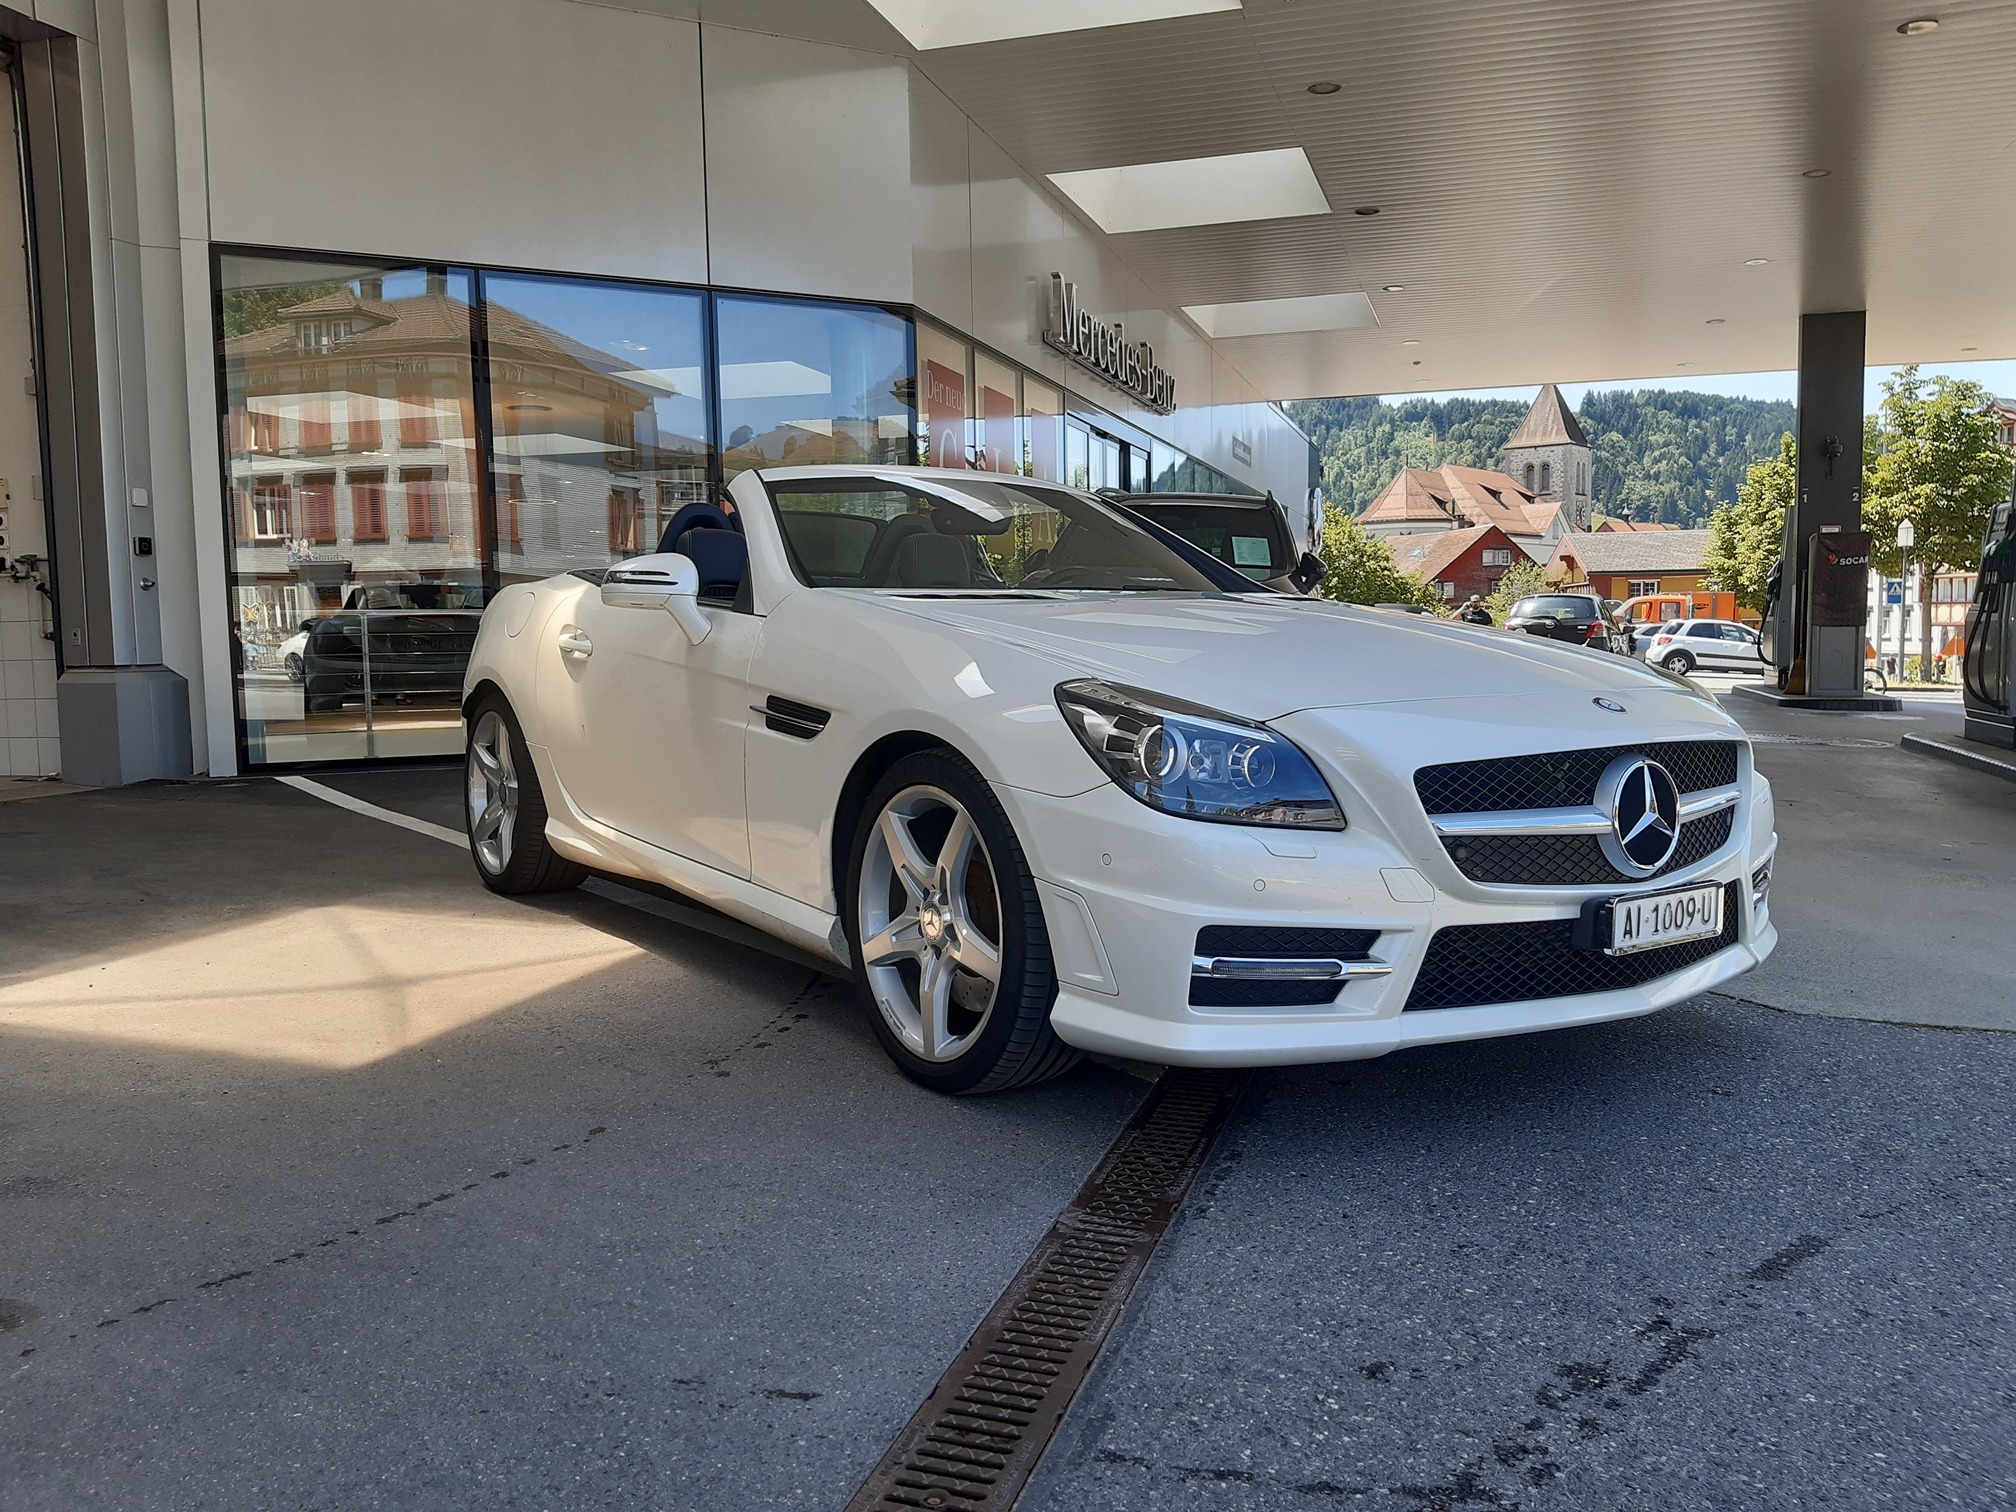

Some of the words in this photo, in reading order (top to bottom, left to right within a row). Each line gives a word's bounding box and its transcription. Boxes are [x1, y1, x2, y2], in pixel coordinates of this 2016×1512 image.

[1057, 271, 1177, 412] Mercedes-Benz
[927, 369, 944, 403] Der
[945, 385, 966, 413] neue
